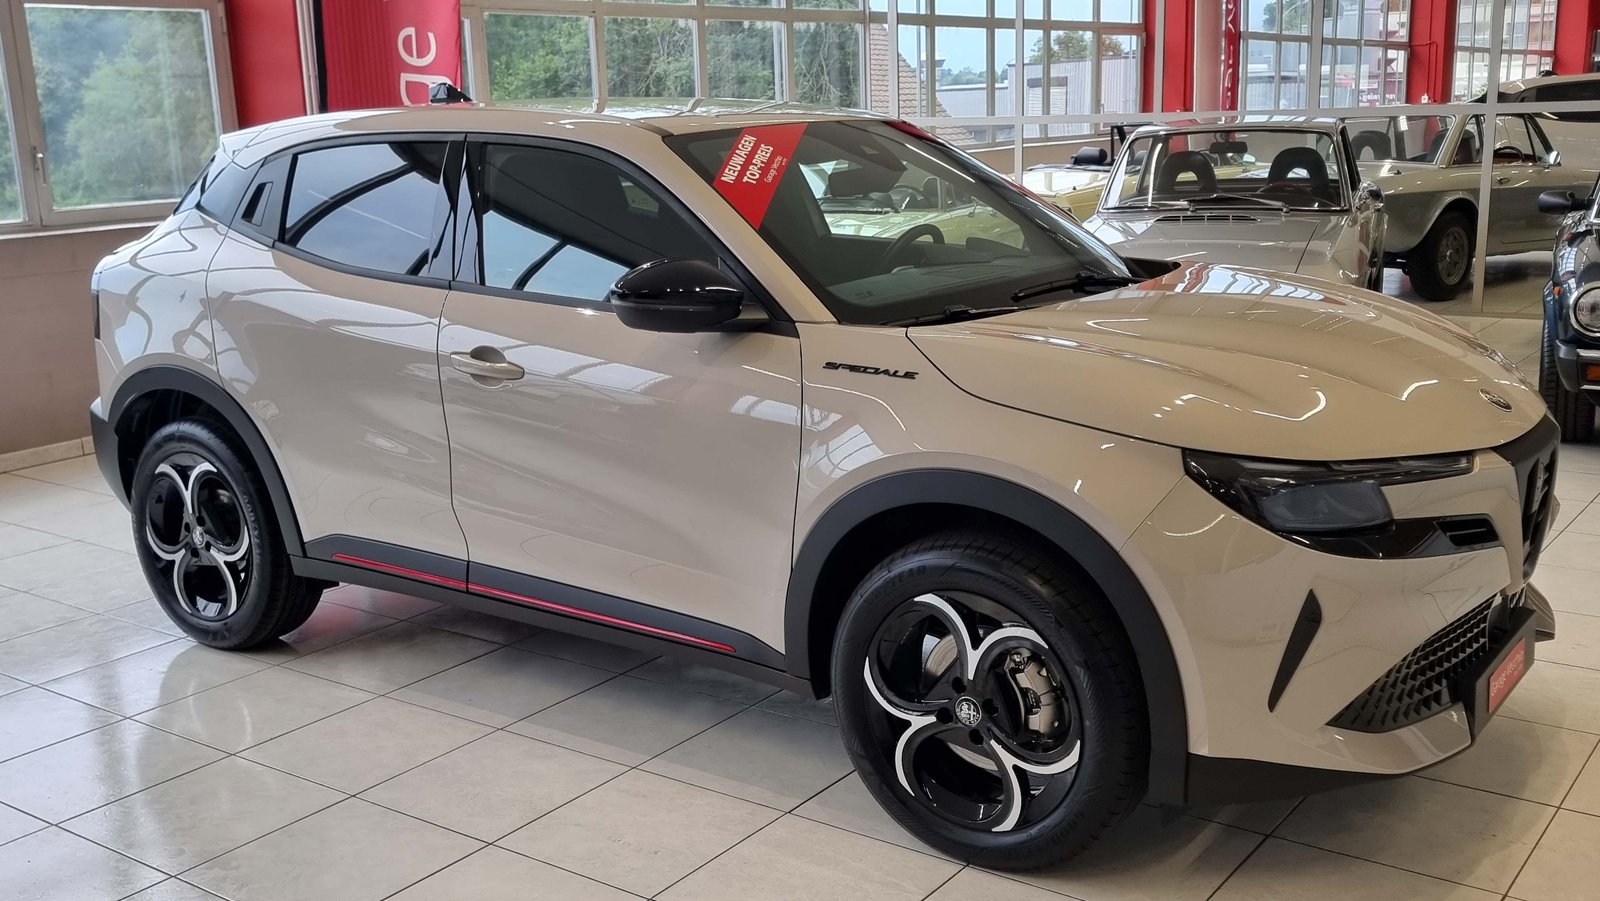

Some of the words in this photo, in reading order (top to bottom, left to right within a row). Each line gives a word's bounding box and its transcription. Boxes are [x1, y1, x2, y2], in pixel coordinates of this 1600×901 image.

[720, 134, 757, 183] NEUWAGEN
[742, 143, 774, 184] TOP-PREIS
[763, 168, 778, 183] Garage
[823, 361, 919, 380] SPECIALE
